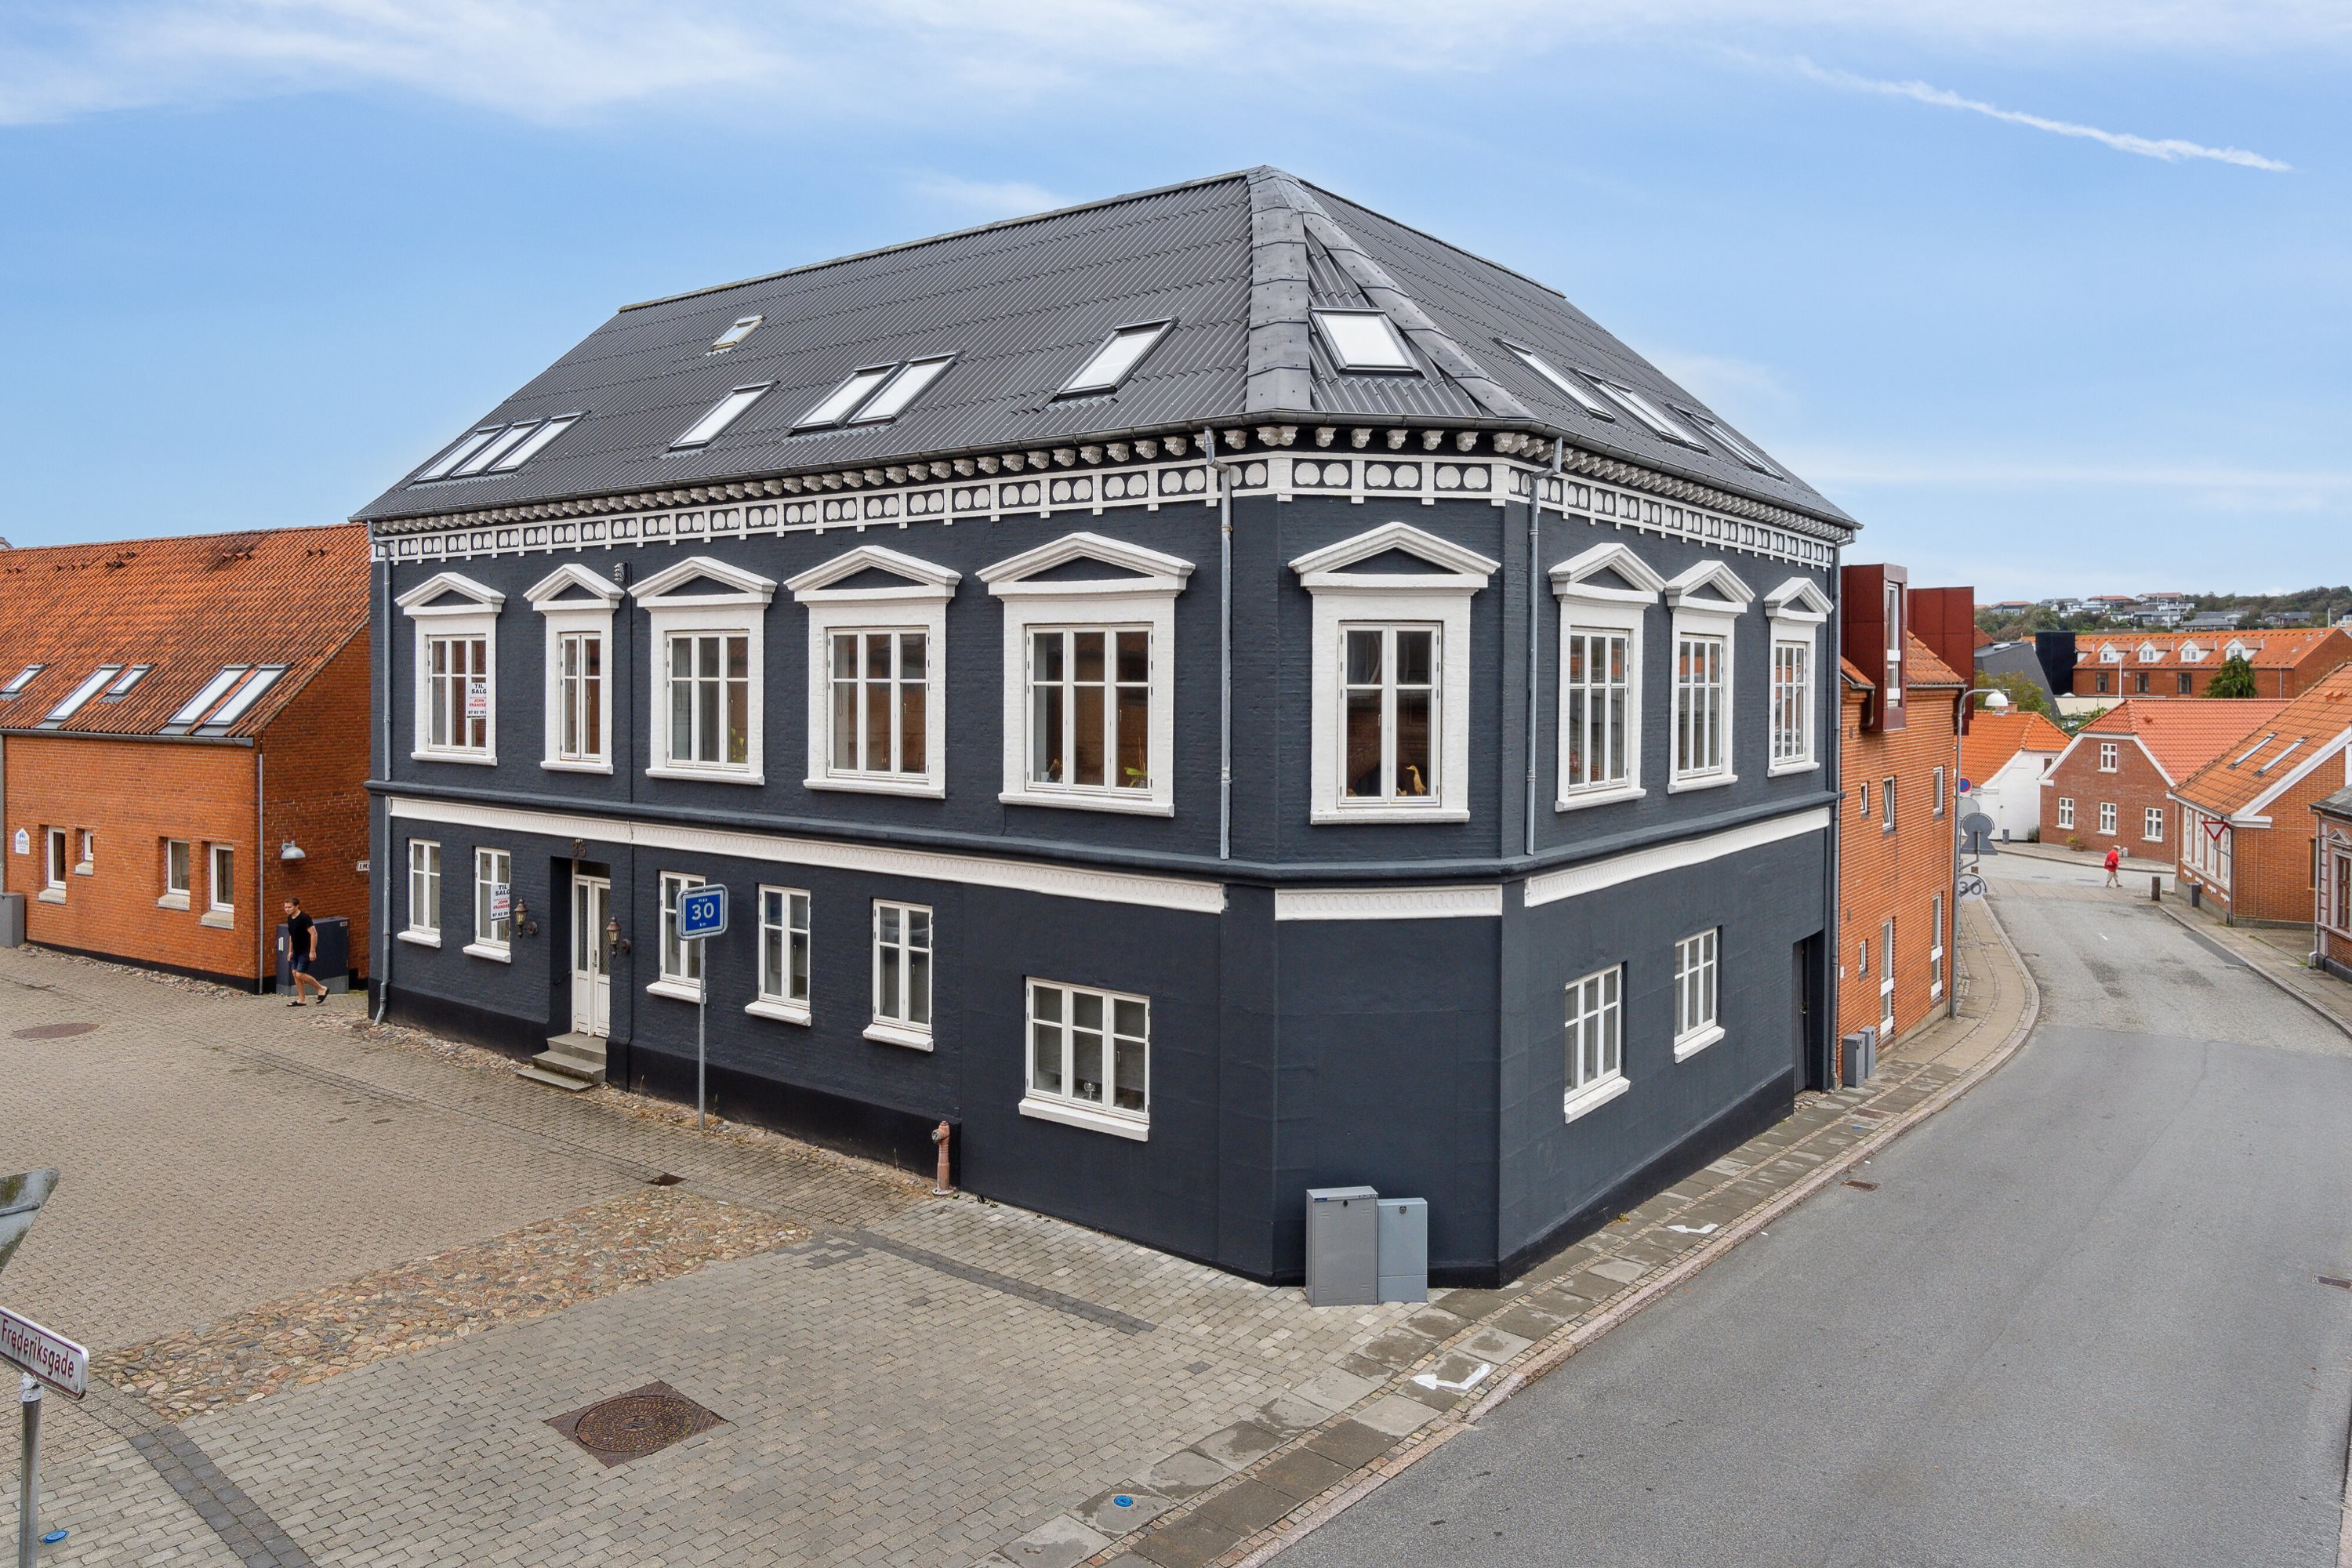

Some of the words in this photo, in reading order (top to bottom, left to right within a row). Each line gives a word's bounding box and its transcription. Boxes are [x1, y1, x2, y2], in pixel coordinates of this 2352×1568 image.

[1959, 880, 1982, 895] 30
[691, 902, 715, 920] 30
[2, 1319, 74, 1378] Frederiksgade
